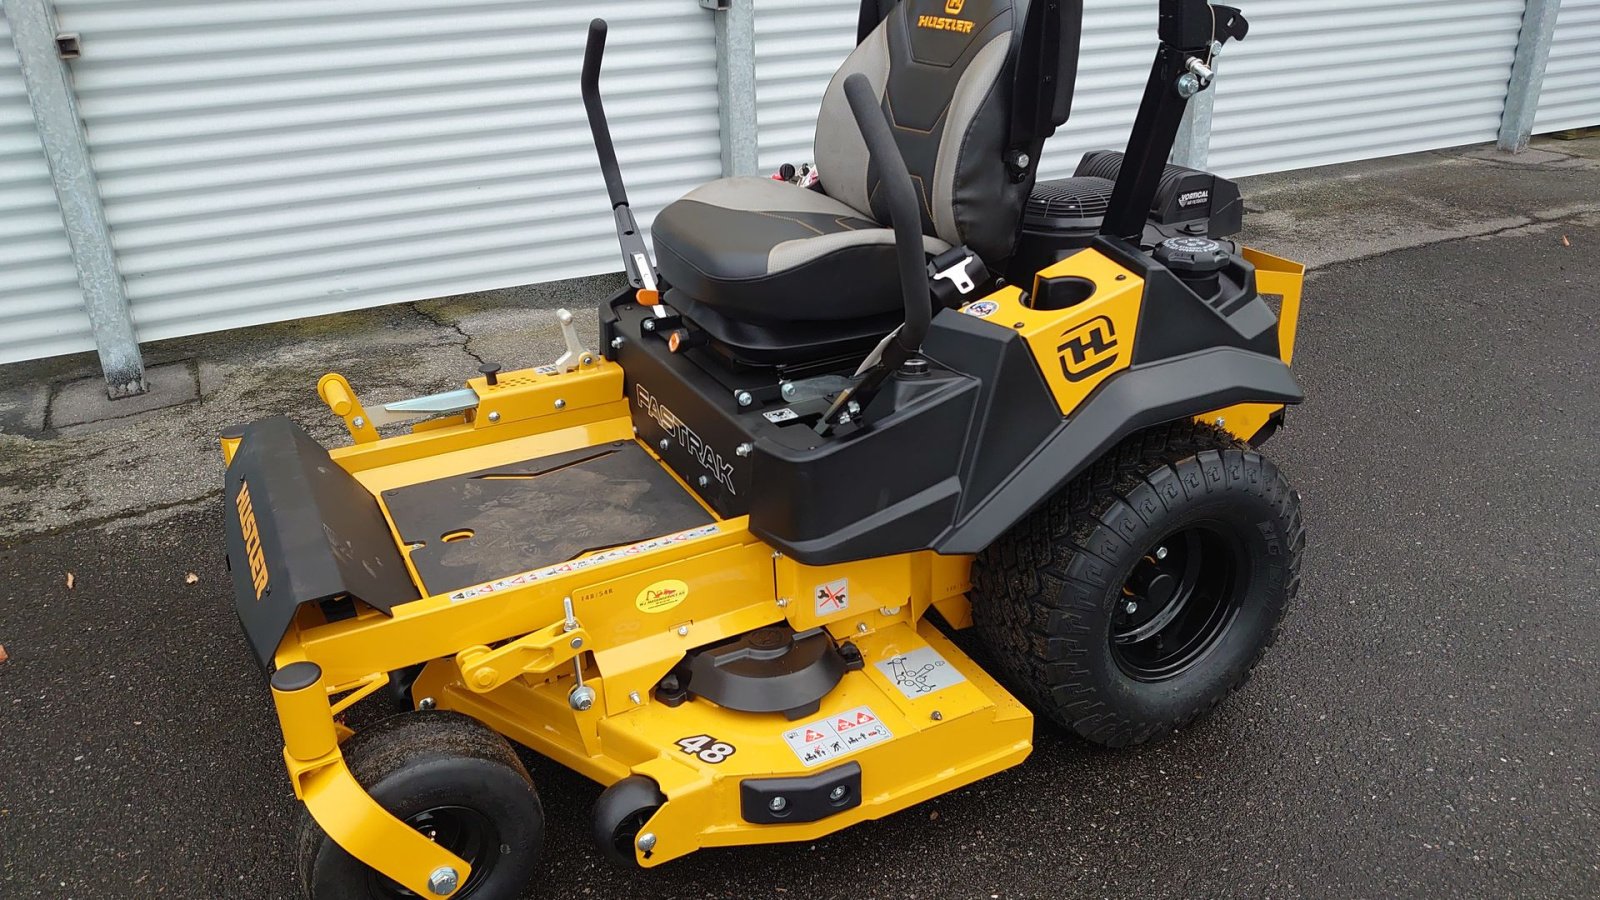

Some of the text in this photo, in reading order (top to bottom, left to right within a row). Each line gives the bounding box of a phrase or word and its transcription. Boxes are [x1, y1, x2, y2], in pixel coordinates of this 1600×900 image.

[917, 15, 974, 33] HUSTLER
[636, 383, 736, 496] FASTRAK
[236, 480, 269, 601] HUSTLER
[674, 733, 736, 764] 48
